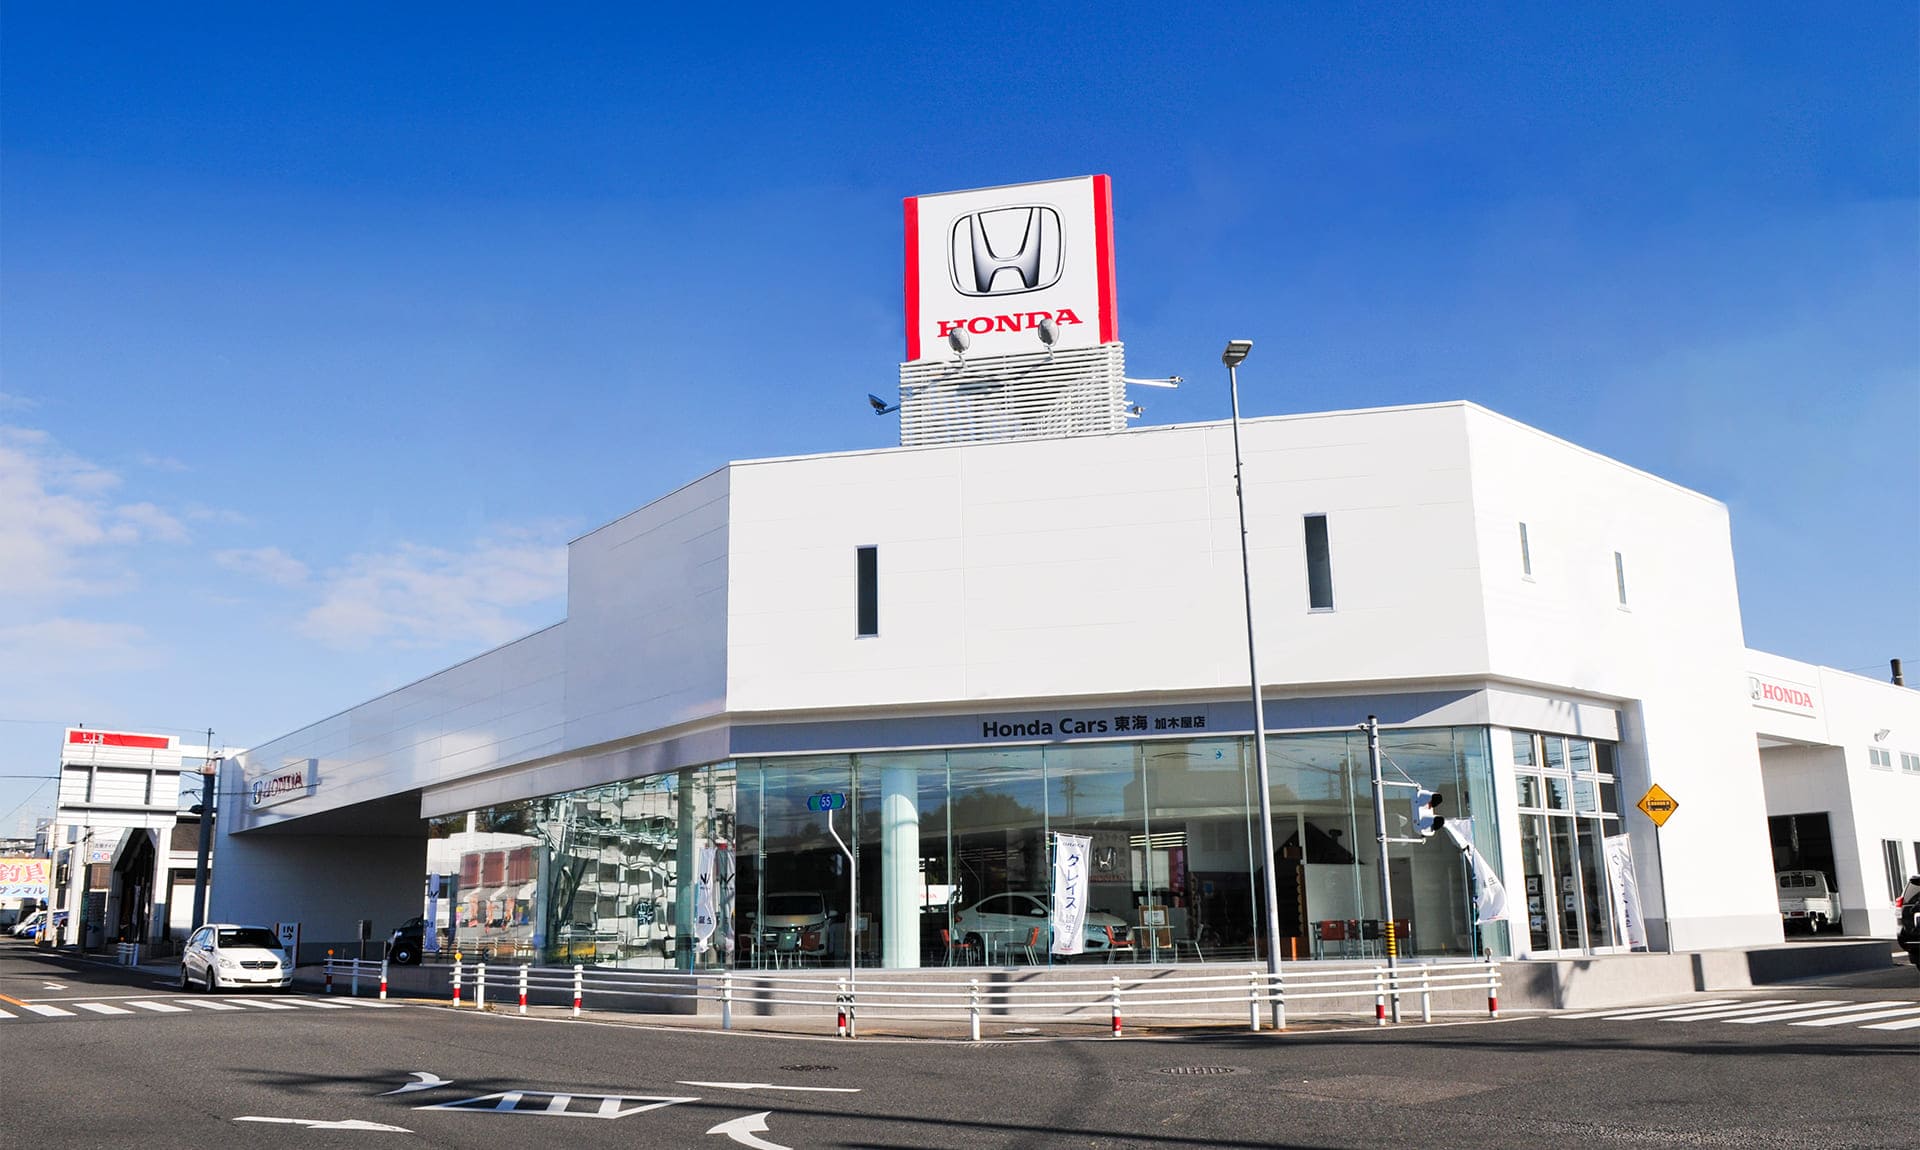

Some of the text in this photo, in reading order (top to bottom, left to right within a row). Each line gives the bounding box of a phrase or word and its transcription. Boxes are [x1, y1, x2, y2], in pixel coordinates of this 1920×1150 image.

[937, 308, 1083, 338] HONDA
[1761, 682, 1814, 709] HONDA
[982, 715, 1206, 738] Honda Cars 東海 加木屋店
[821, 796, 831, 808] 55
[0, 863, 46, 883] 釣具
[283, 925, 294, 934] IN
